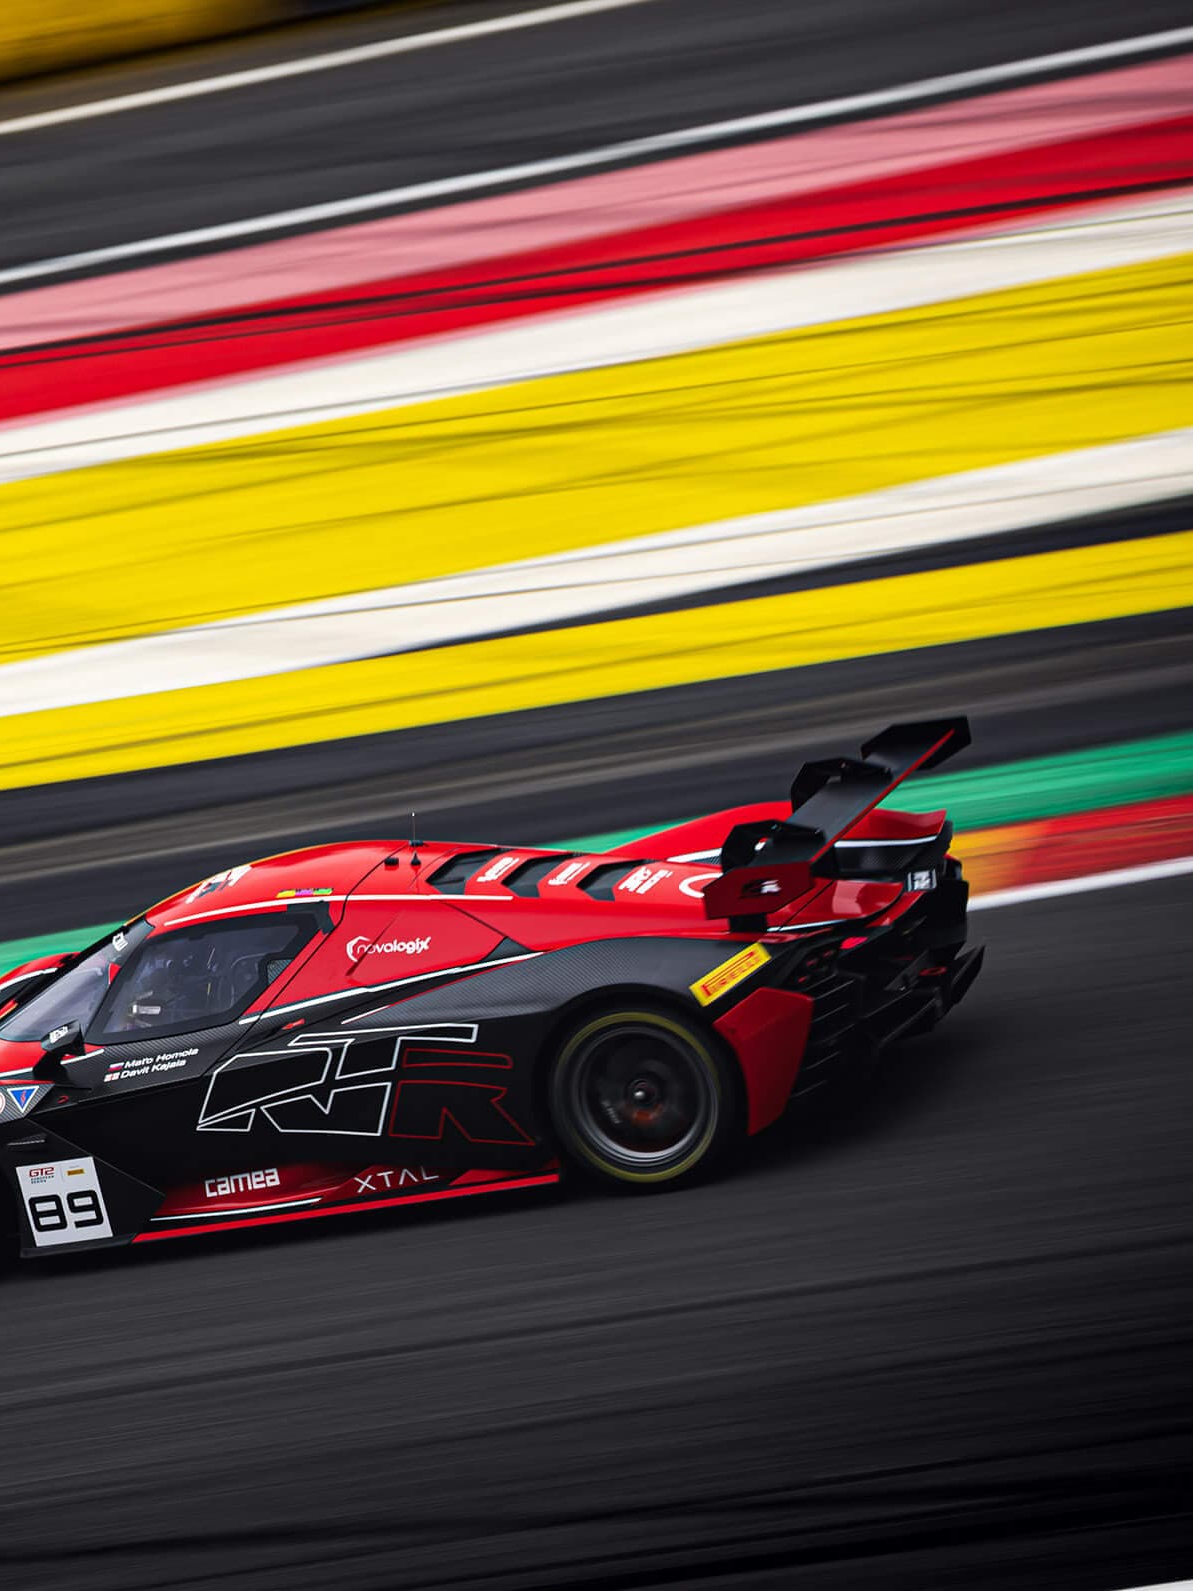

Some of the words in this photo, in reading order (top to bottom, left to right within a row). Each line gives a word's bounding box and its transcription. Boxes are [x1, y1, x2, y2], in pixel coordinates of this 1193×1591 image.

[357, 936, 431, 954] novalogix
[205, 1168, 281, 1197] camea
[28, 1190, 104, 1232] 89
